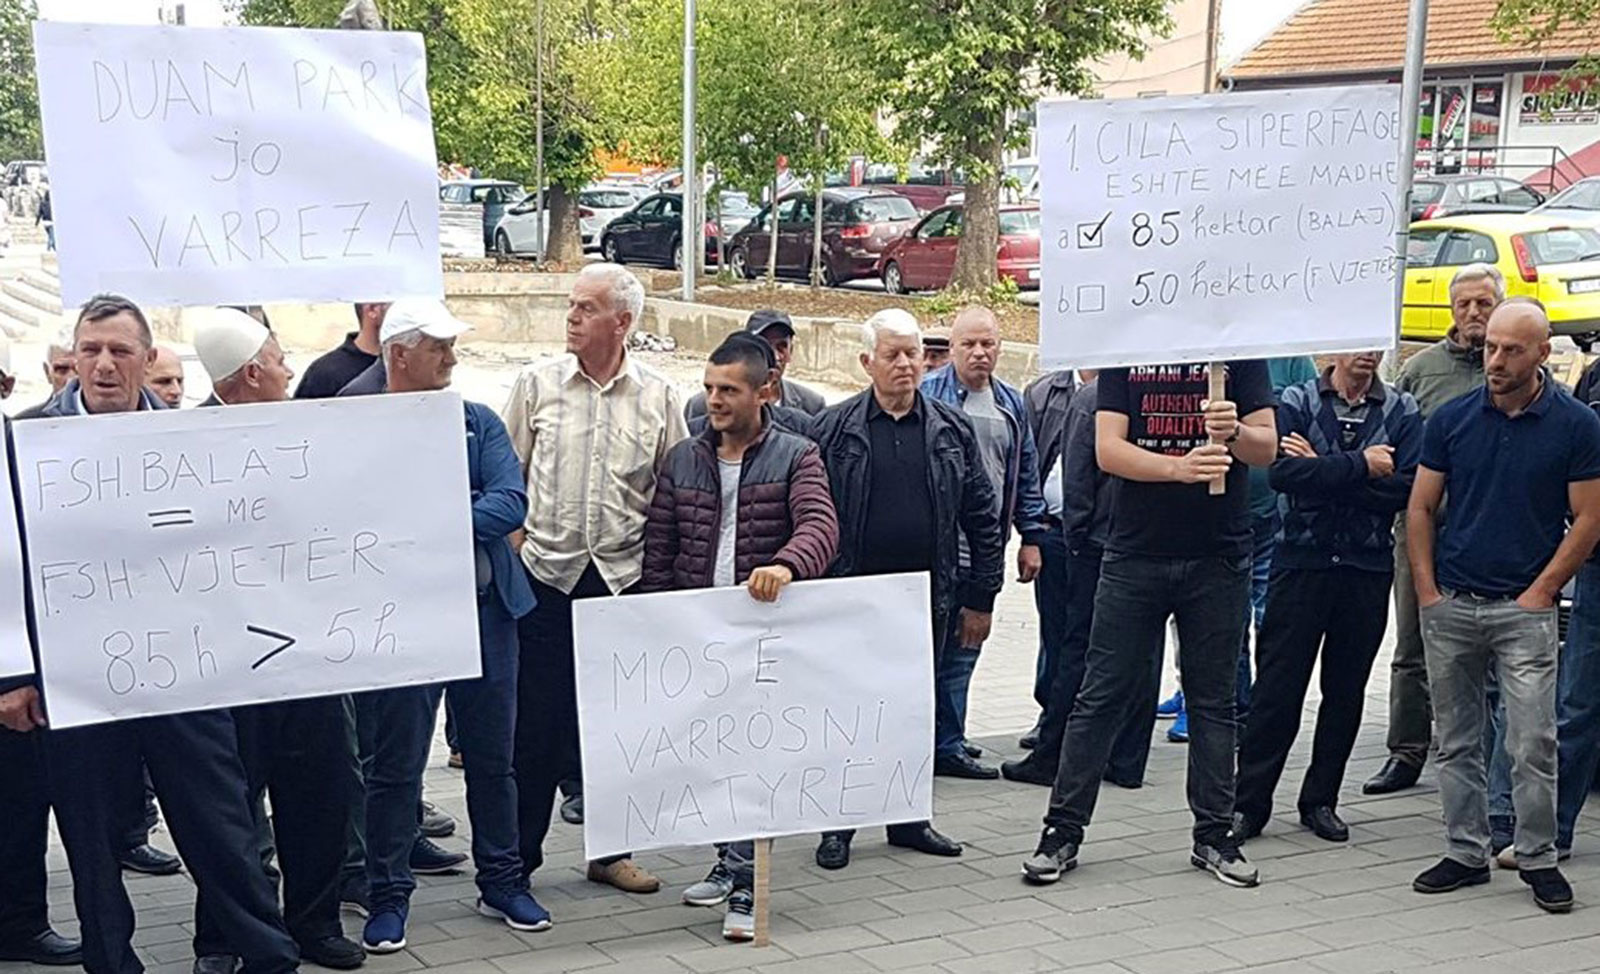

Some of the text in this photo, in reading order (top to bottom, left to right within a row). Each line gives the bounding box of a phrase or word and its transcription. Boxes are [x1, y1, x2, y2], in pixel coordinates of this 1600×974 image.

[93, 59, 430, 123] DUAM PARK
[1097, 121, 1192, 164] CILA
[1310, 161, 1398, 187] MADHE
[129, 200, 424, 268] VARREZA
[1191, 204, 1282, 240] hektar
[1298, 192, 1396, 241] (BALAJ)
[1191, 260, 1298, 299] hektar
[1128, 365, 1181, 382] ARMANI
[1147, 416, 1206, 435] QUALITY
[227, 497, 267, 522] ME
[626, 755, 931, 845] NATYRËN
